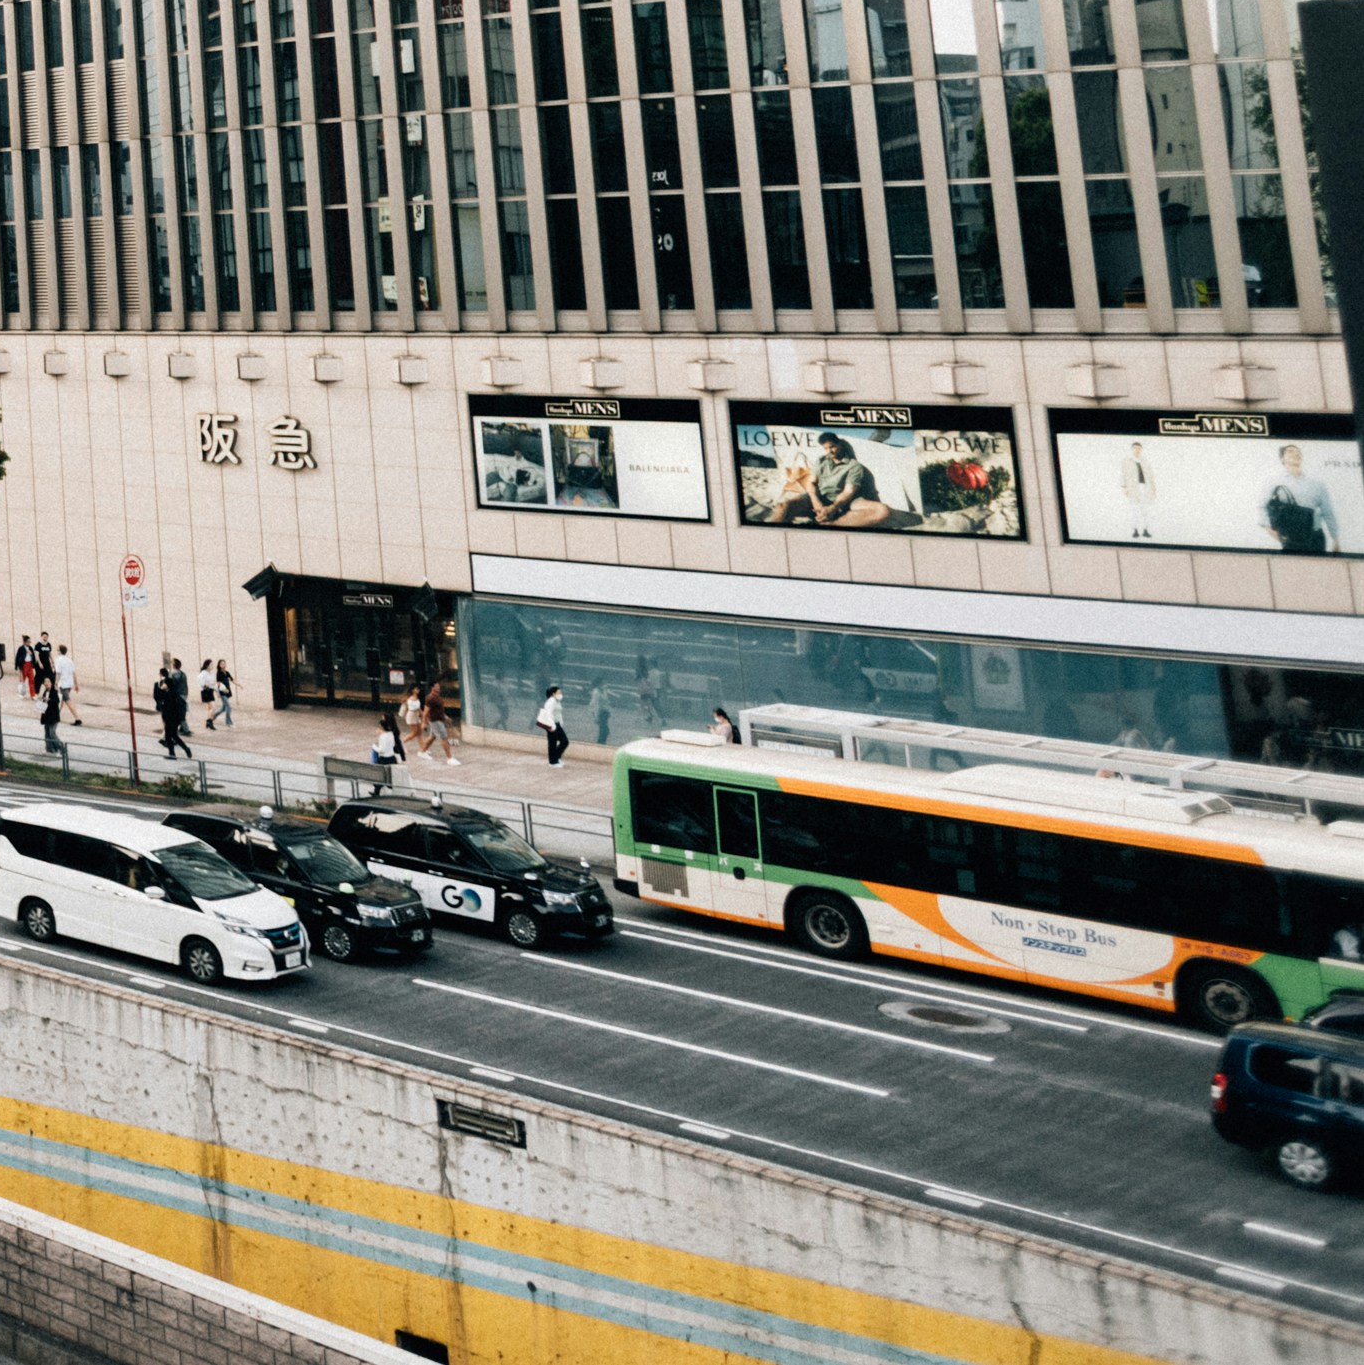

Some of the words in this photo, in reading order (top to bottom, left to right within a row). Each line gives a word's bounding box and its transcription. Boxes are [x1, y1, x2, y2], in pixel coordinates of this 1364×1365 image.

[575, 402, 617, 415] MENS
[856, 409, 909, 424] MENS
[1202, 417, 1264, 433] MENS
[196, 413, 318, 470] 阪急
[743, 430, 817, 448] LOEWE
[922, 436, 1004, 454] LOEWE
[628, 463, 691, 474] BALENCIAGA
[1083, 928, 1118, 948] Bus
